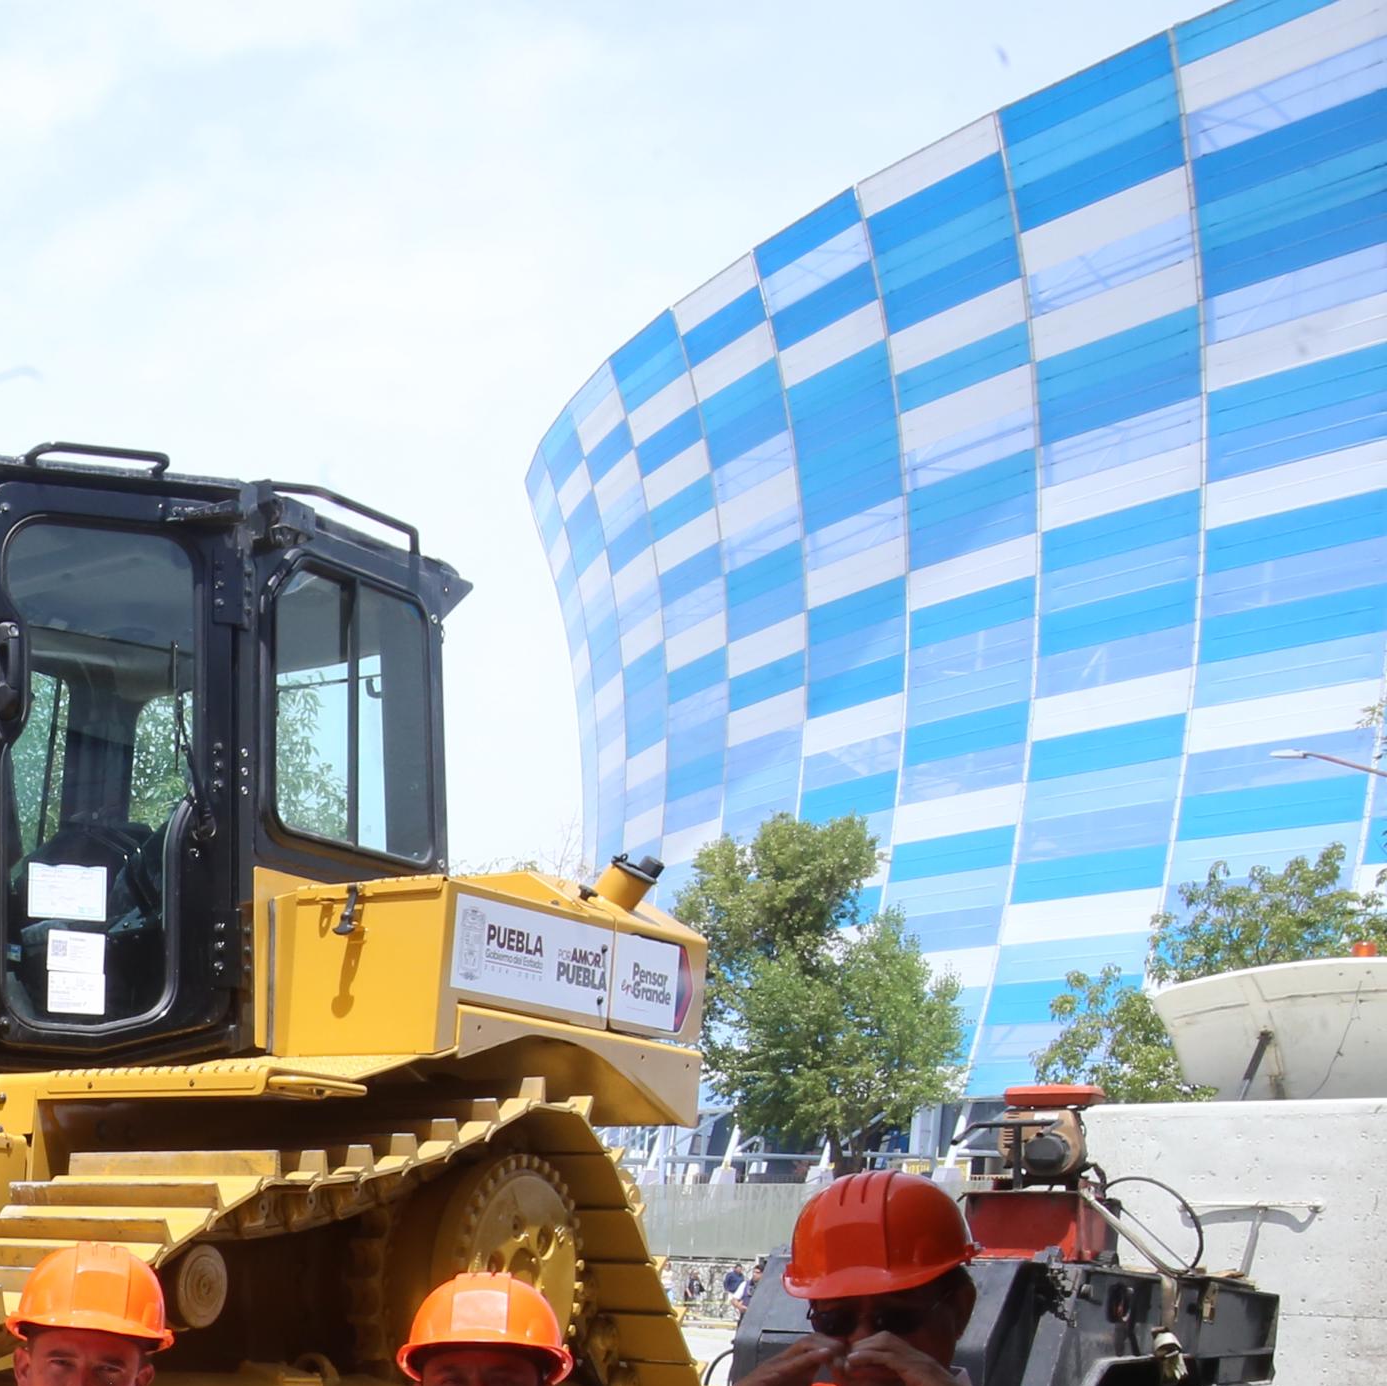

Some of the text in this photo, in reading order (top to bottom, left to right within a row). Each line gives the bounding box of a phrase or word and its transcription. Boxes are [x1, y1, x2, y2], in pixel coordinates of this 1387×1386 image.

[487, 924, 544, 957] PUEBLA
[571, 948, 601, 968] AMOR
[557, 962, 607, 991] PUEBLA
[632, 962, 669, 987] Pensar
[632, 981, 671, 1005] Grande
